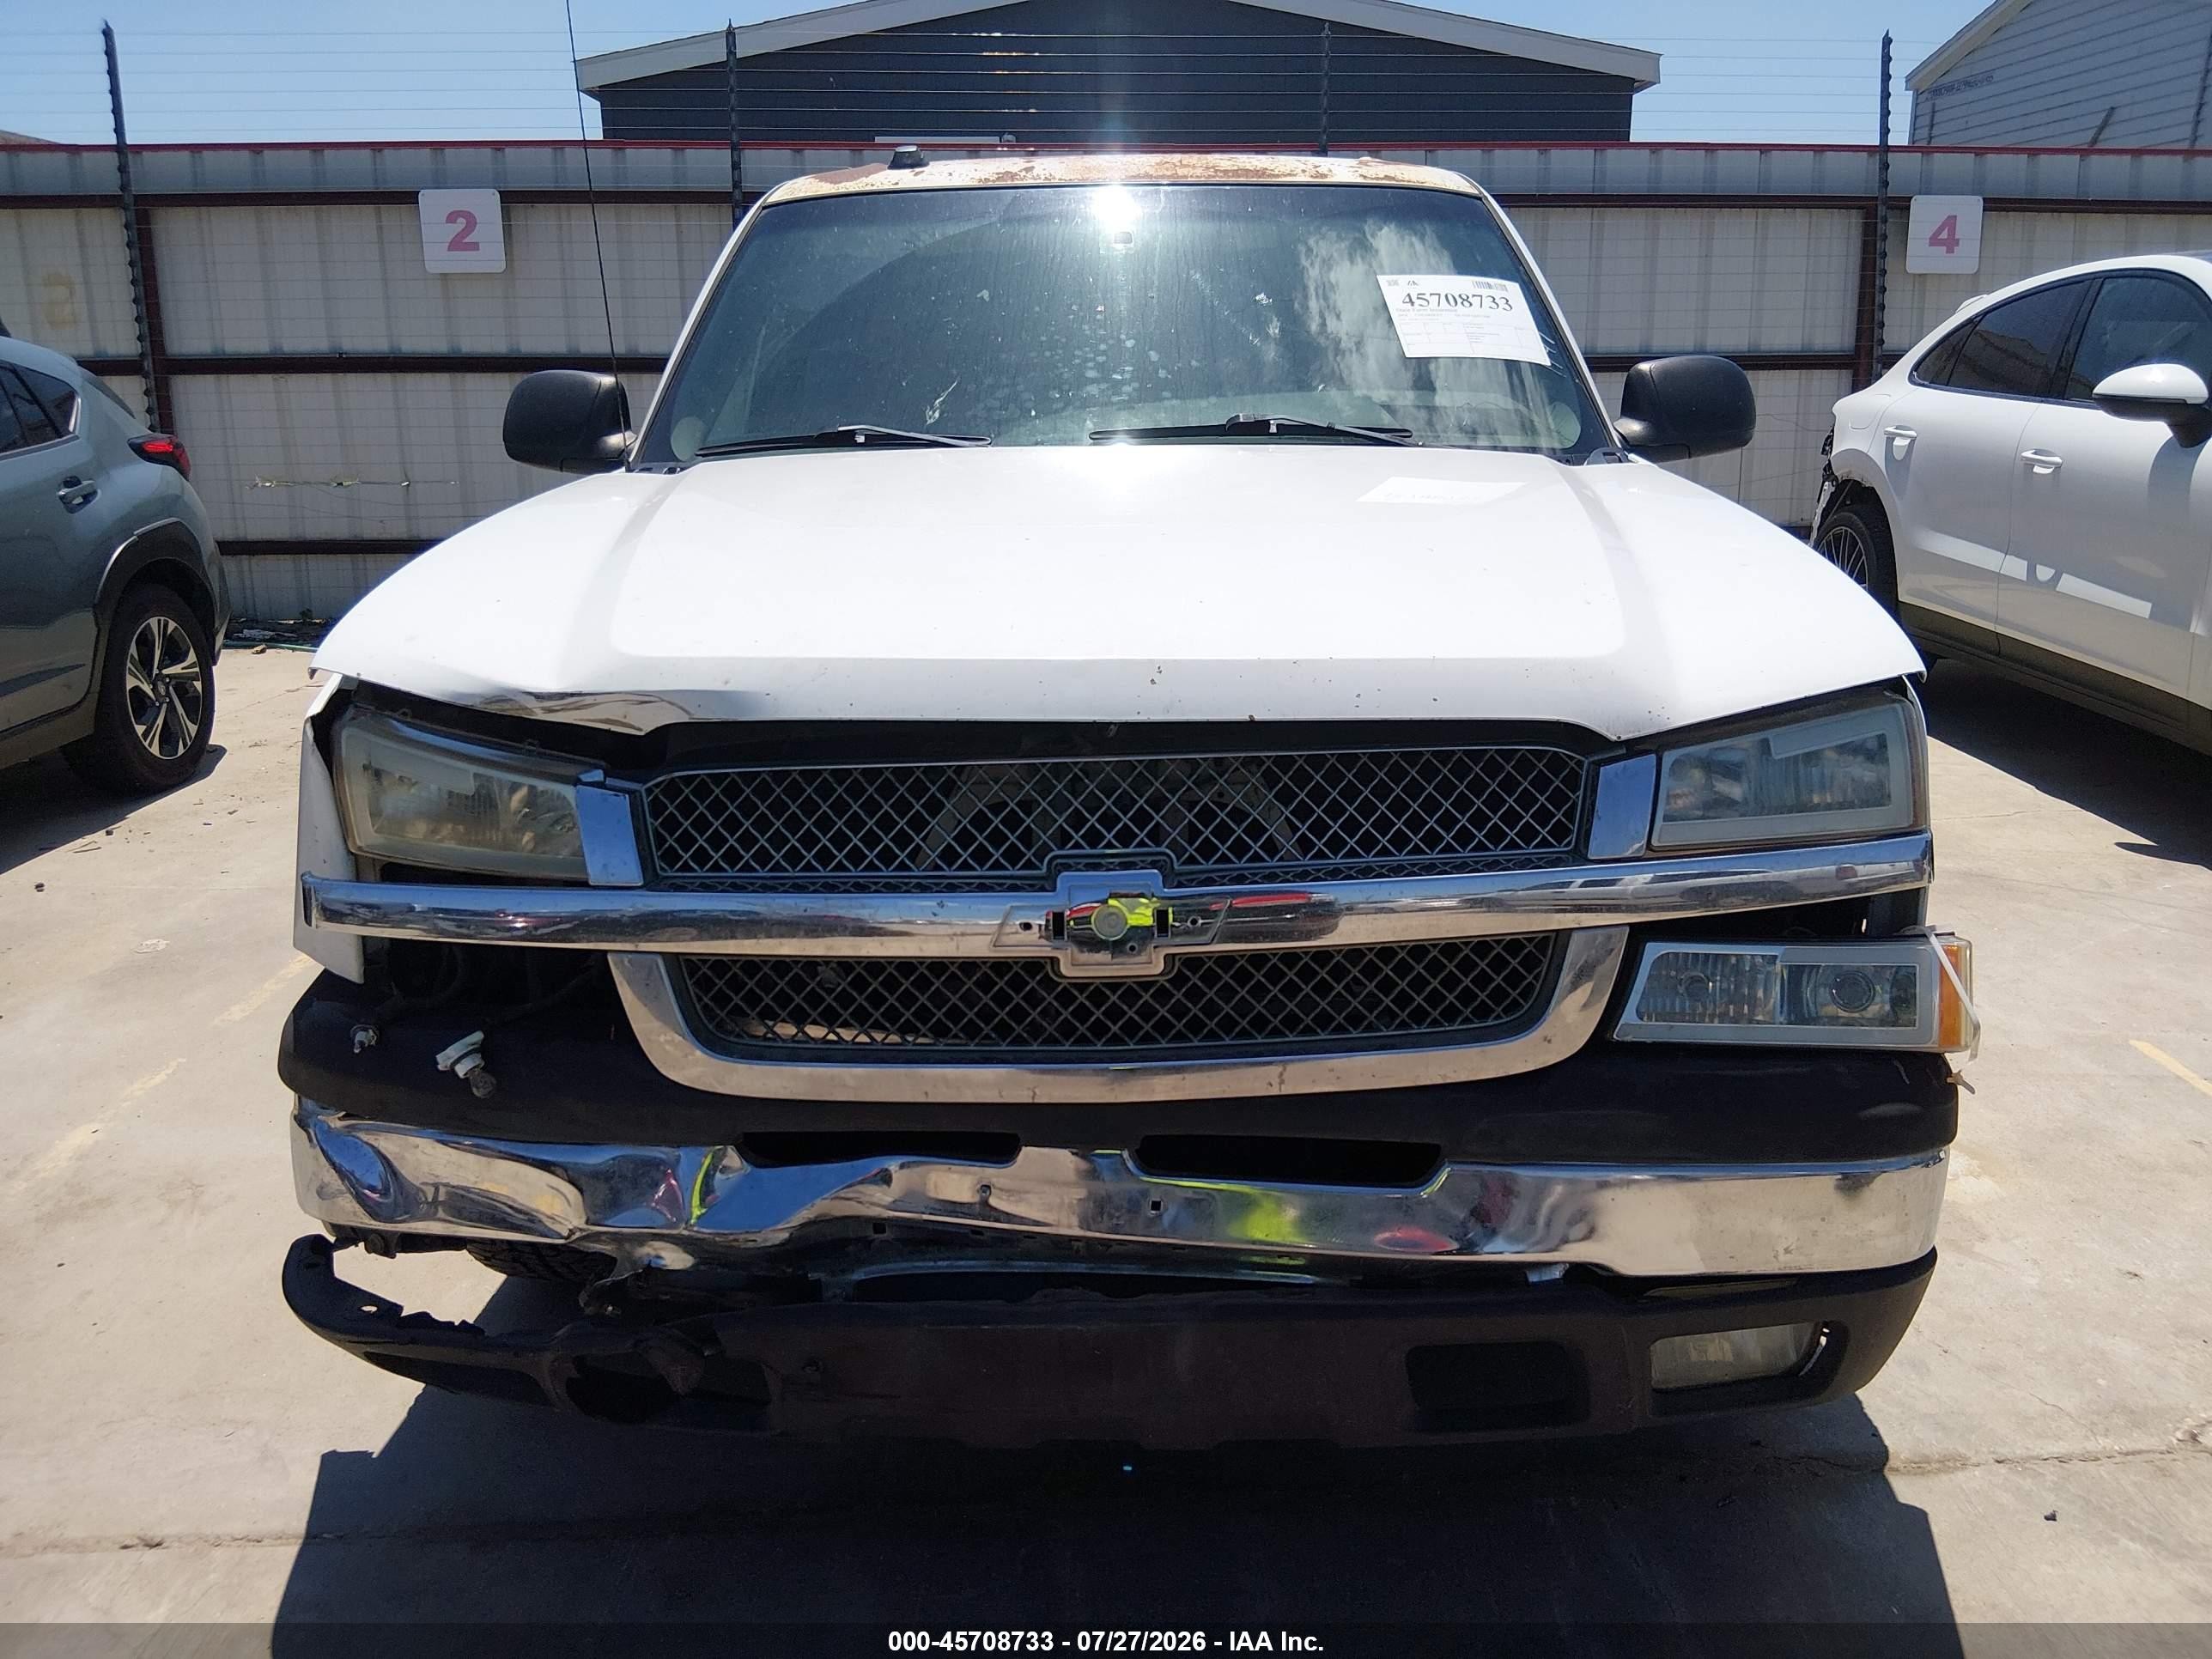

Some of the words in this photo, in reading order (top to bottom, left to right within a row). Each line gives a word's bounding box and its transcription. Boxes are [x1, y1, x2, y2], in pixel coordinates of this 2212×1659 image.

[445, 210, 480, 252] 2
[1928, 215, 1960, 254] 4
[1401, 292, 1513, 312] 45708733
